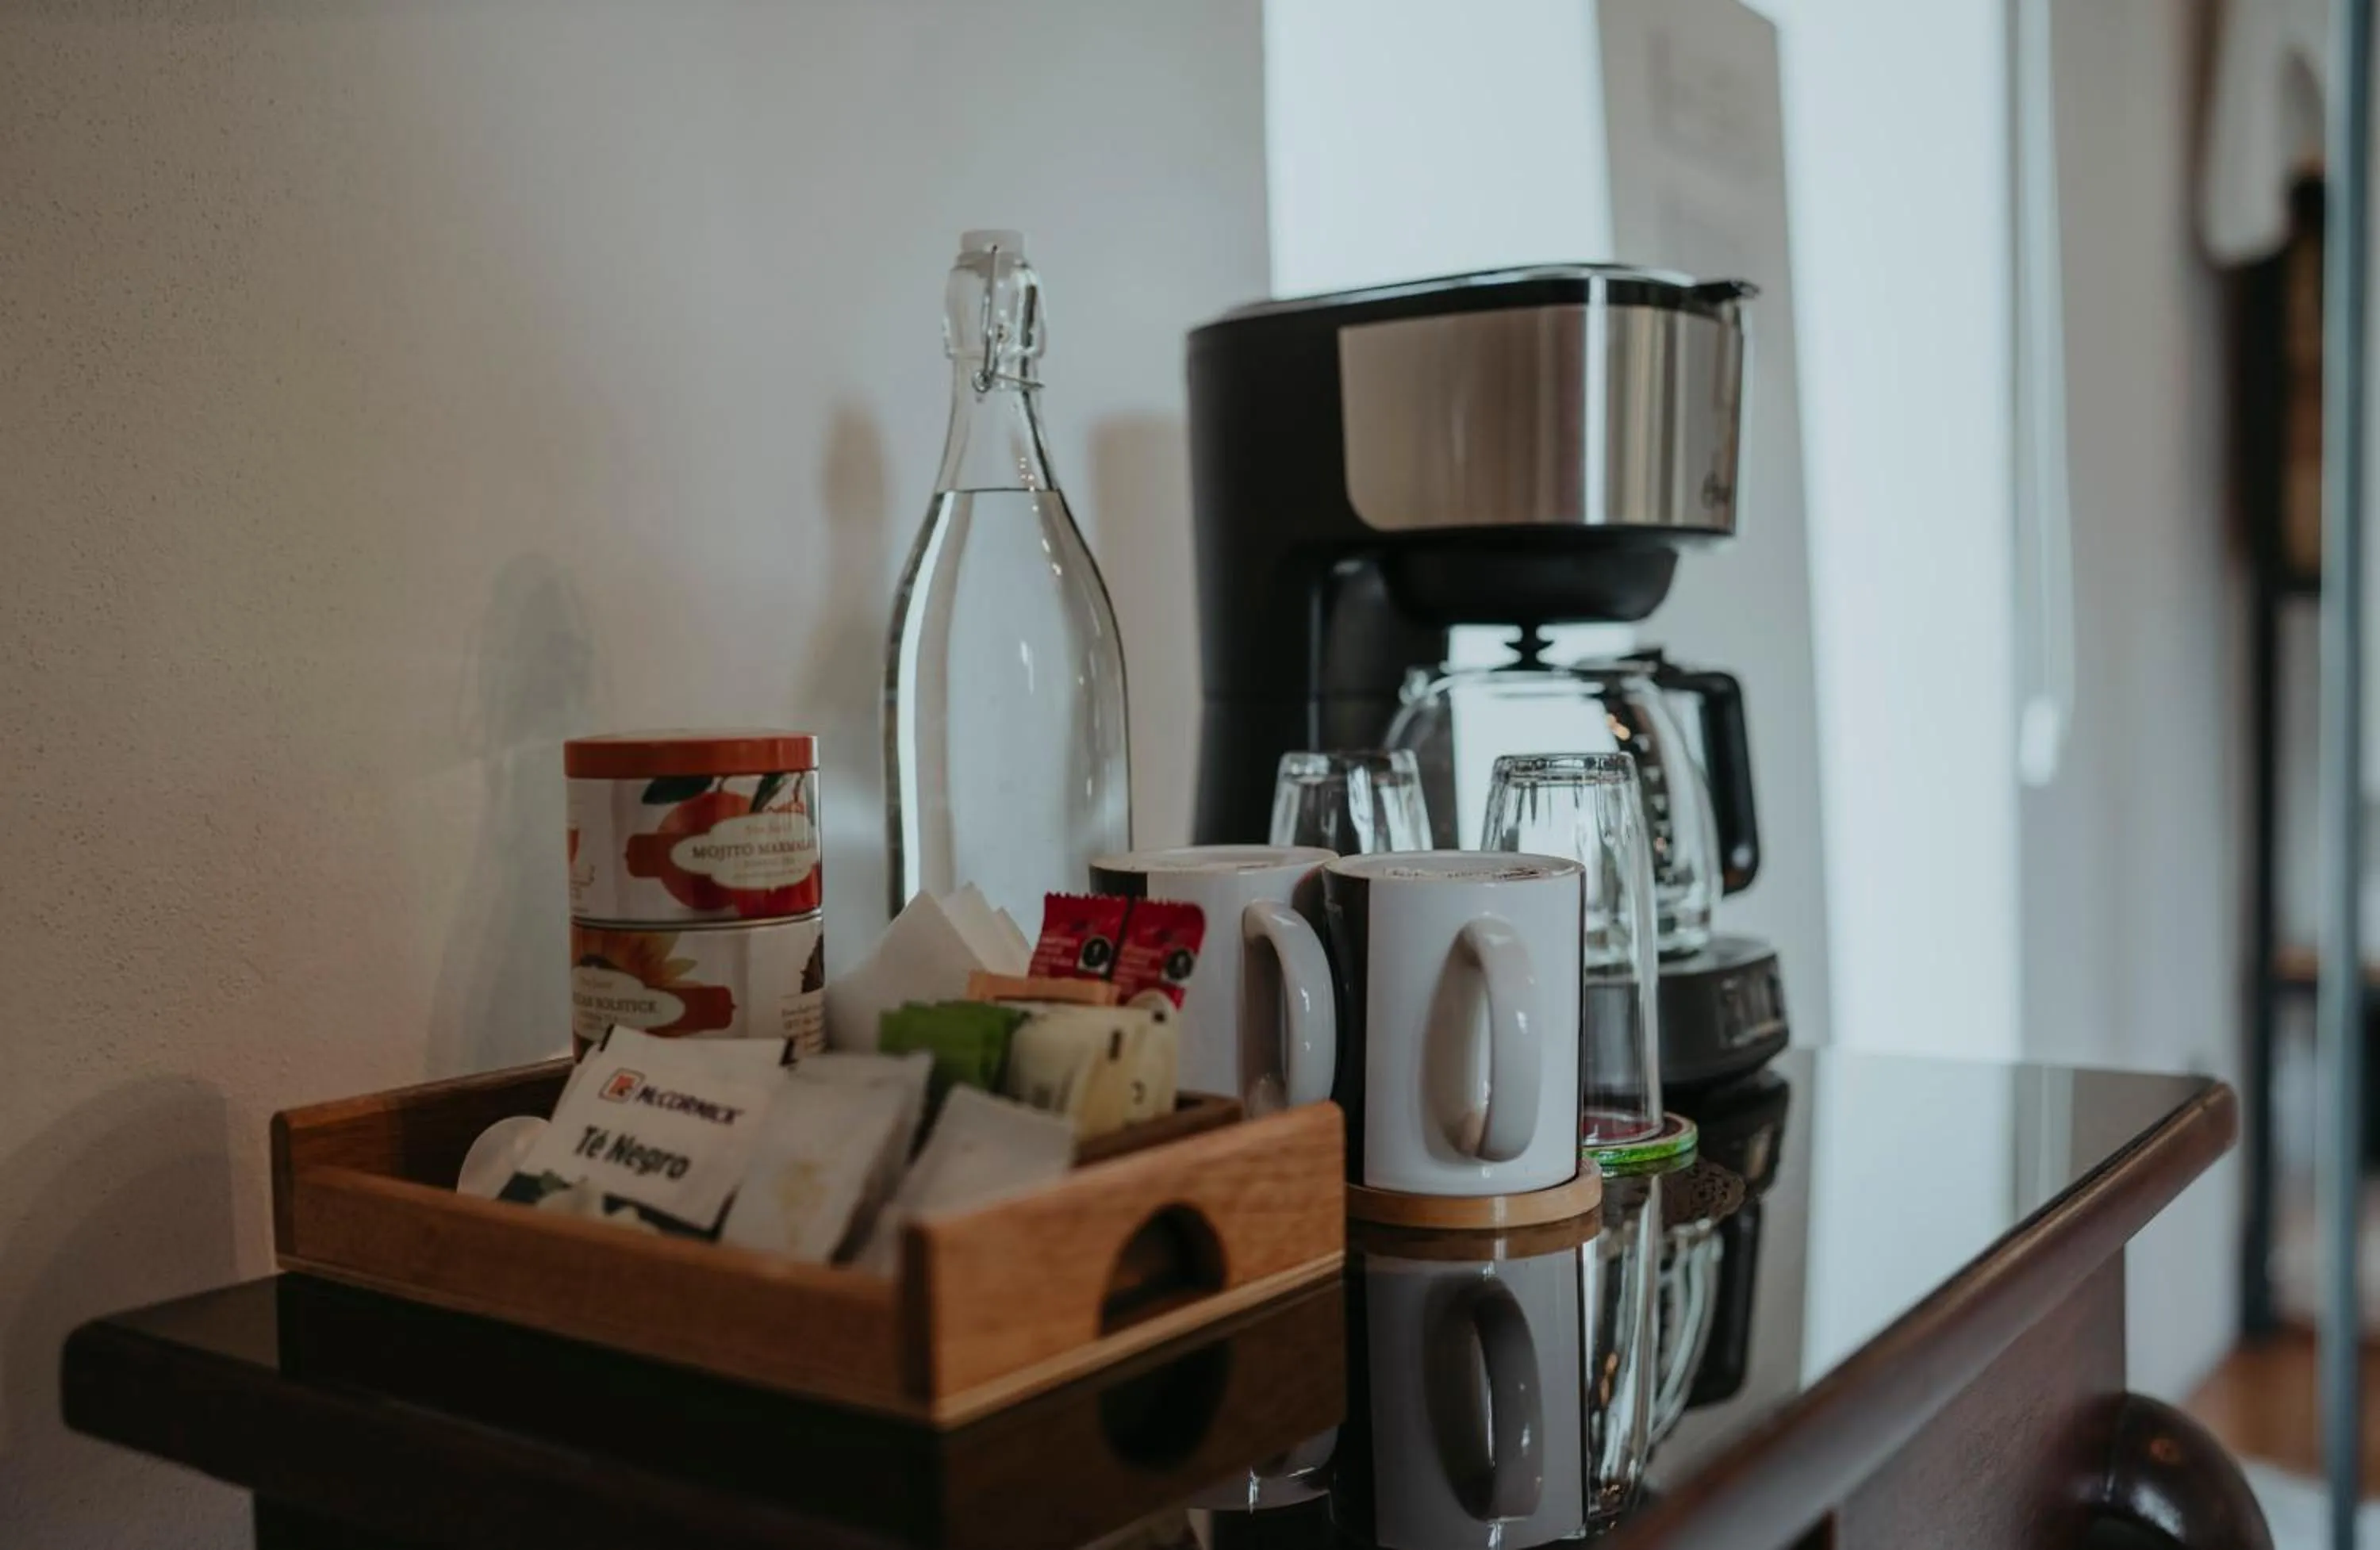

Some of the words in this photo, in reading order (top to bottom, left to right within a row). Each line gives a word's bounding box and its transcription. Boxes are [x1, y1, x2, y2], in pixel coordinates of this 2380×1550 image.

[692, 842, 754, 861] MOJITO
[574, 1125, 608, 1158] Té
[604, 1134, 690, 1179] Negro
